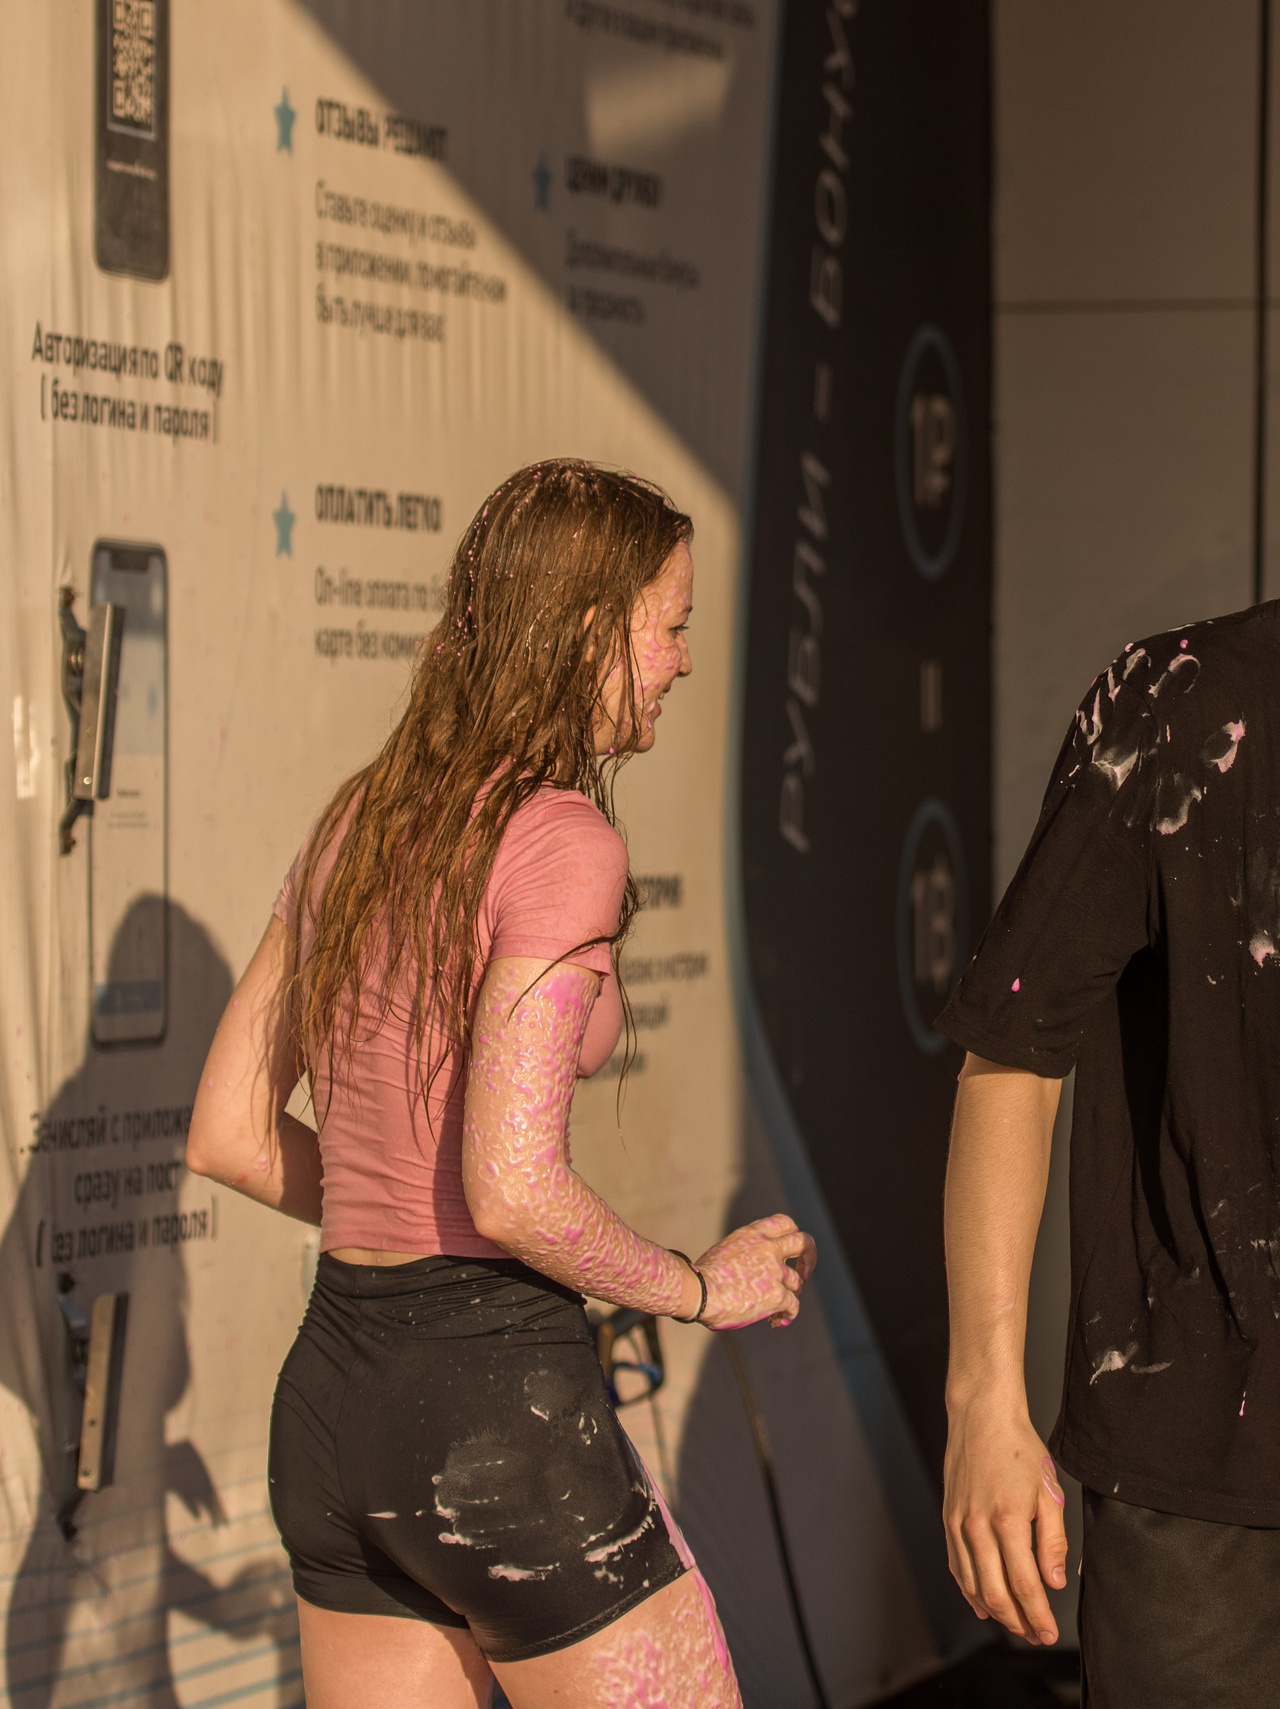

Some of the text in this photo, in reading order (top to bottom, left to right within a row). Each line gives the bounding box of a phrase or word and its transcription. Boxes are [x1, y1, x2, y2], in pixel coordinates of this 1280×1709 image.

[315, 96, 380, 149] ОТЗЫВЫ
[31, 319, 224, 398] Авторизация по QR коду
[81, 391, 136, 430] логина
[139, 402, 149, 432] и
[315, 483, 442, 532] ОПЛАТИТЬ ЛЕГКО
[778, 451, 832, 855] РУБЛИ
[74, 1160, 180, 1213] сразу на пост
[76, 1219, 134, 1260] логина
